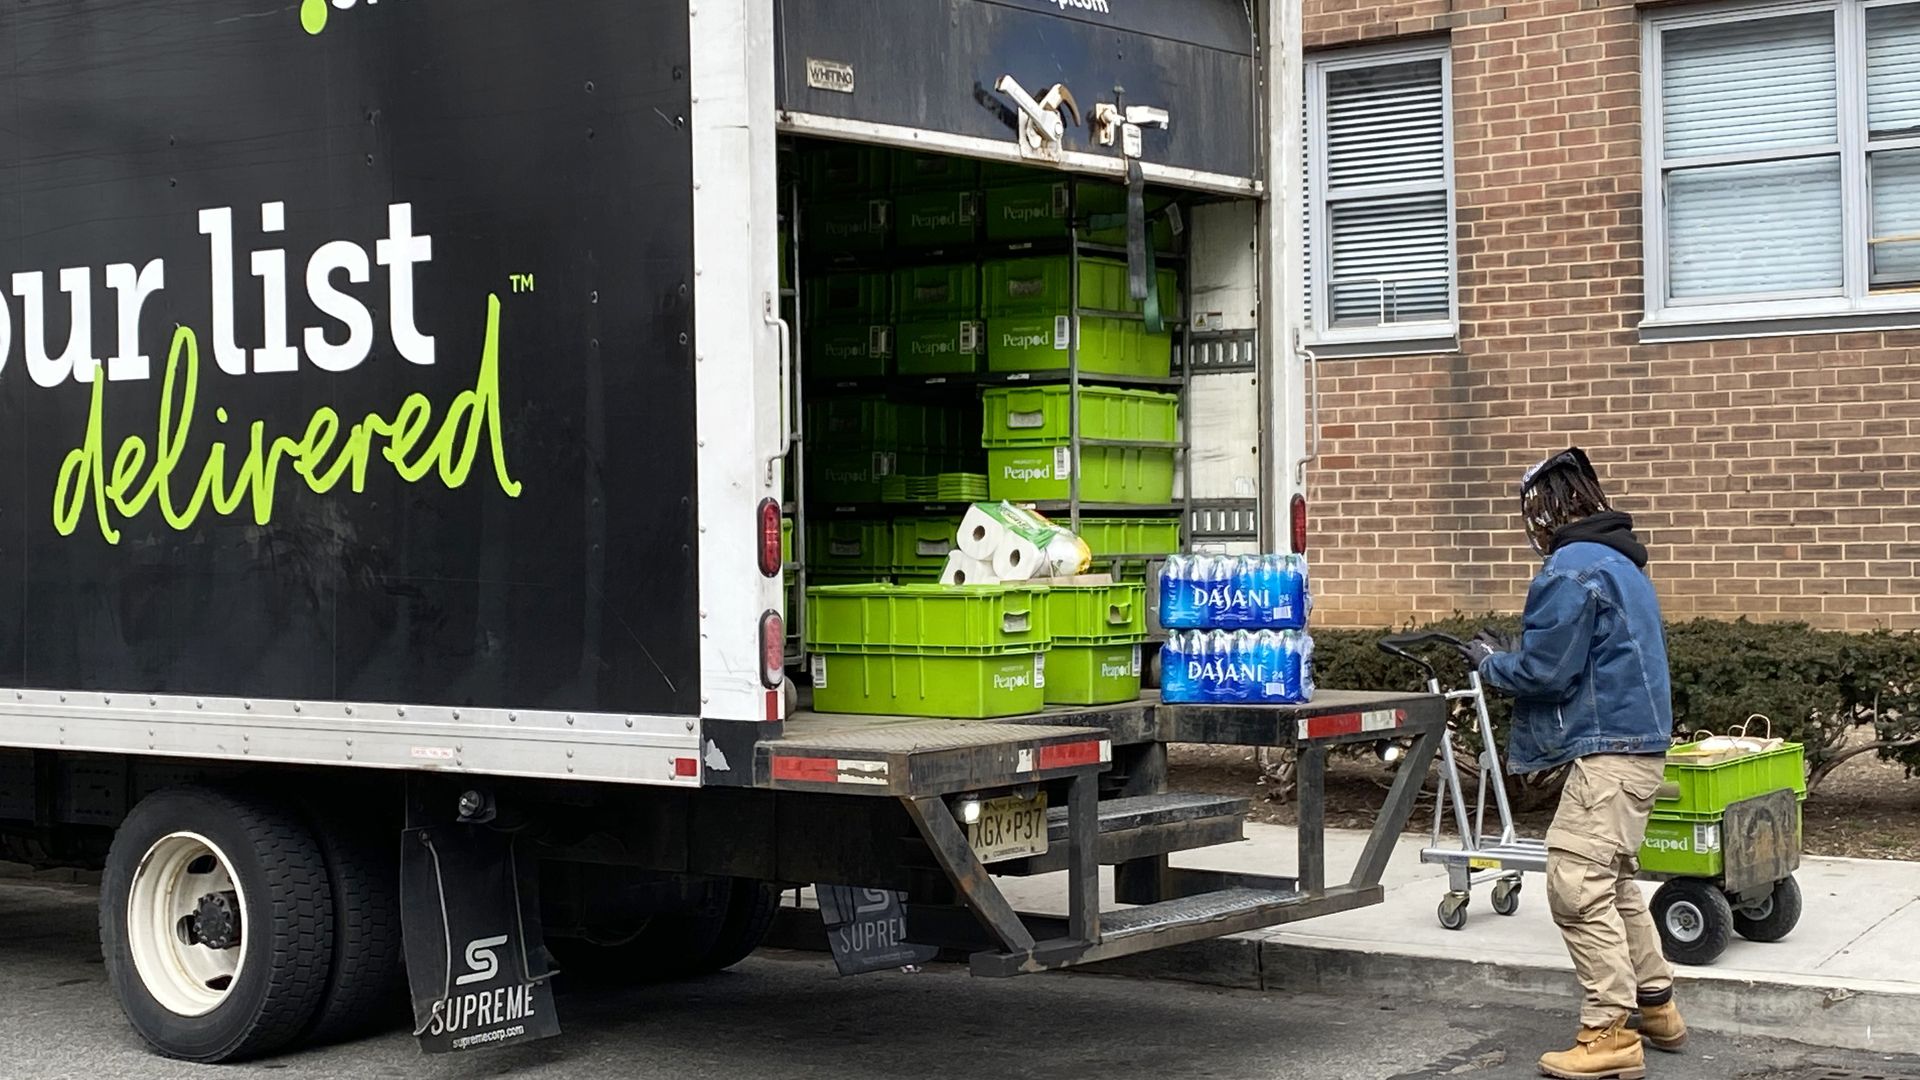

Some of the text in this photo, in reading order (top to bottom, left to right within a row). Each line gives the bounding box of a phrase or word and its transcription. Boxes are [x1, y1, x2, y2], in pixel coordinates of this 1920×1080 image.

[912, 211, 955, 230] Peapod
[1003, 202, 1049, 222] Peapod
[0, 201, 435, 388] ur list
[912, 338, 955, 356] Peapod
[1003, 331, 1049, 350] Peapod
[54, 293, 521, 544] delivered
[1004, 465, 1050, 483] Peapod
[1191, 584, 1270, 613] DASANI
[993, 673, 1030, 691] Peapod
[1101, 662, 1131, 680] Peapod
[1188, 657, 1263, 685] DASANI
[975, 808, 1042, 848] XGX P37
[430, 983, 535, 1036] SUPREME
[452, 1025, 525, 1049] supremecorp.com
